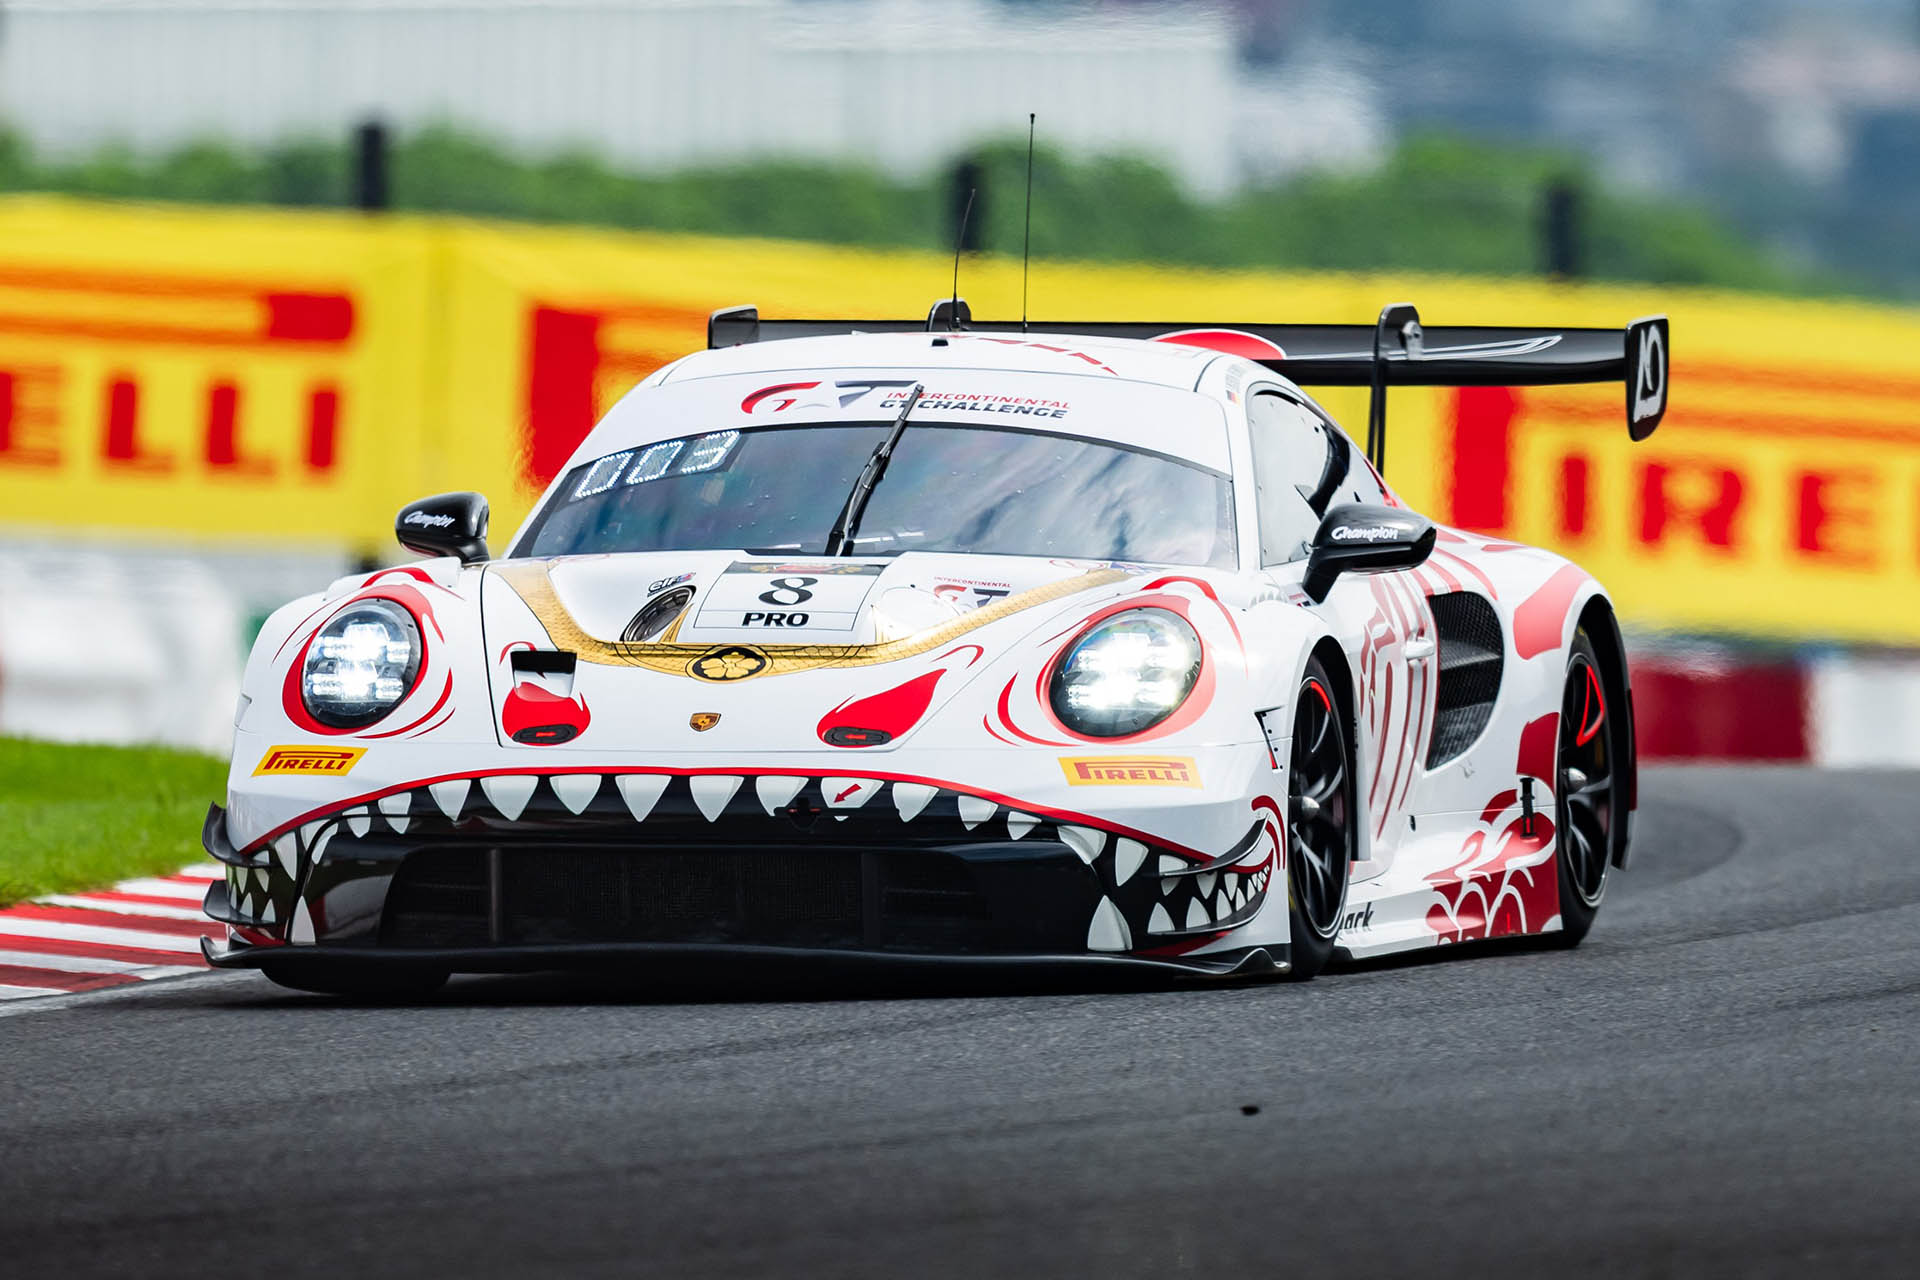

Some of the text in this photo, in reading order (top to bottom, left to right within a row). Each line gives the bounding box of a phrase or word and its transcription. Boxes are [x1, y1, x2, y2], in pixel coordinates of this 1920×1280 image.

[887, 391, 1071, 409] INERCONTINENTAL
[917, 400, 1068, 418] CHALLENGE
[1331, 526, 1399, 542] Champion
[758, 577, 818, 606] 8
[741, 612, 810, 627] PRO
[263, 751, 354, 769] PIRELLI
[1074, 761, 1189, 781] PIRELLI
